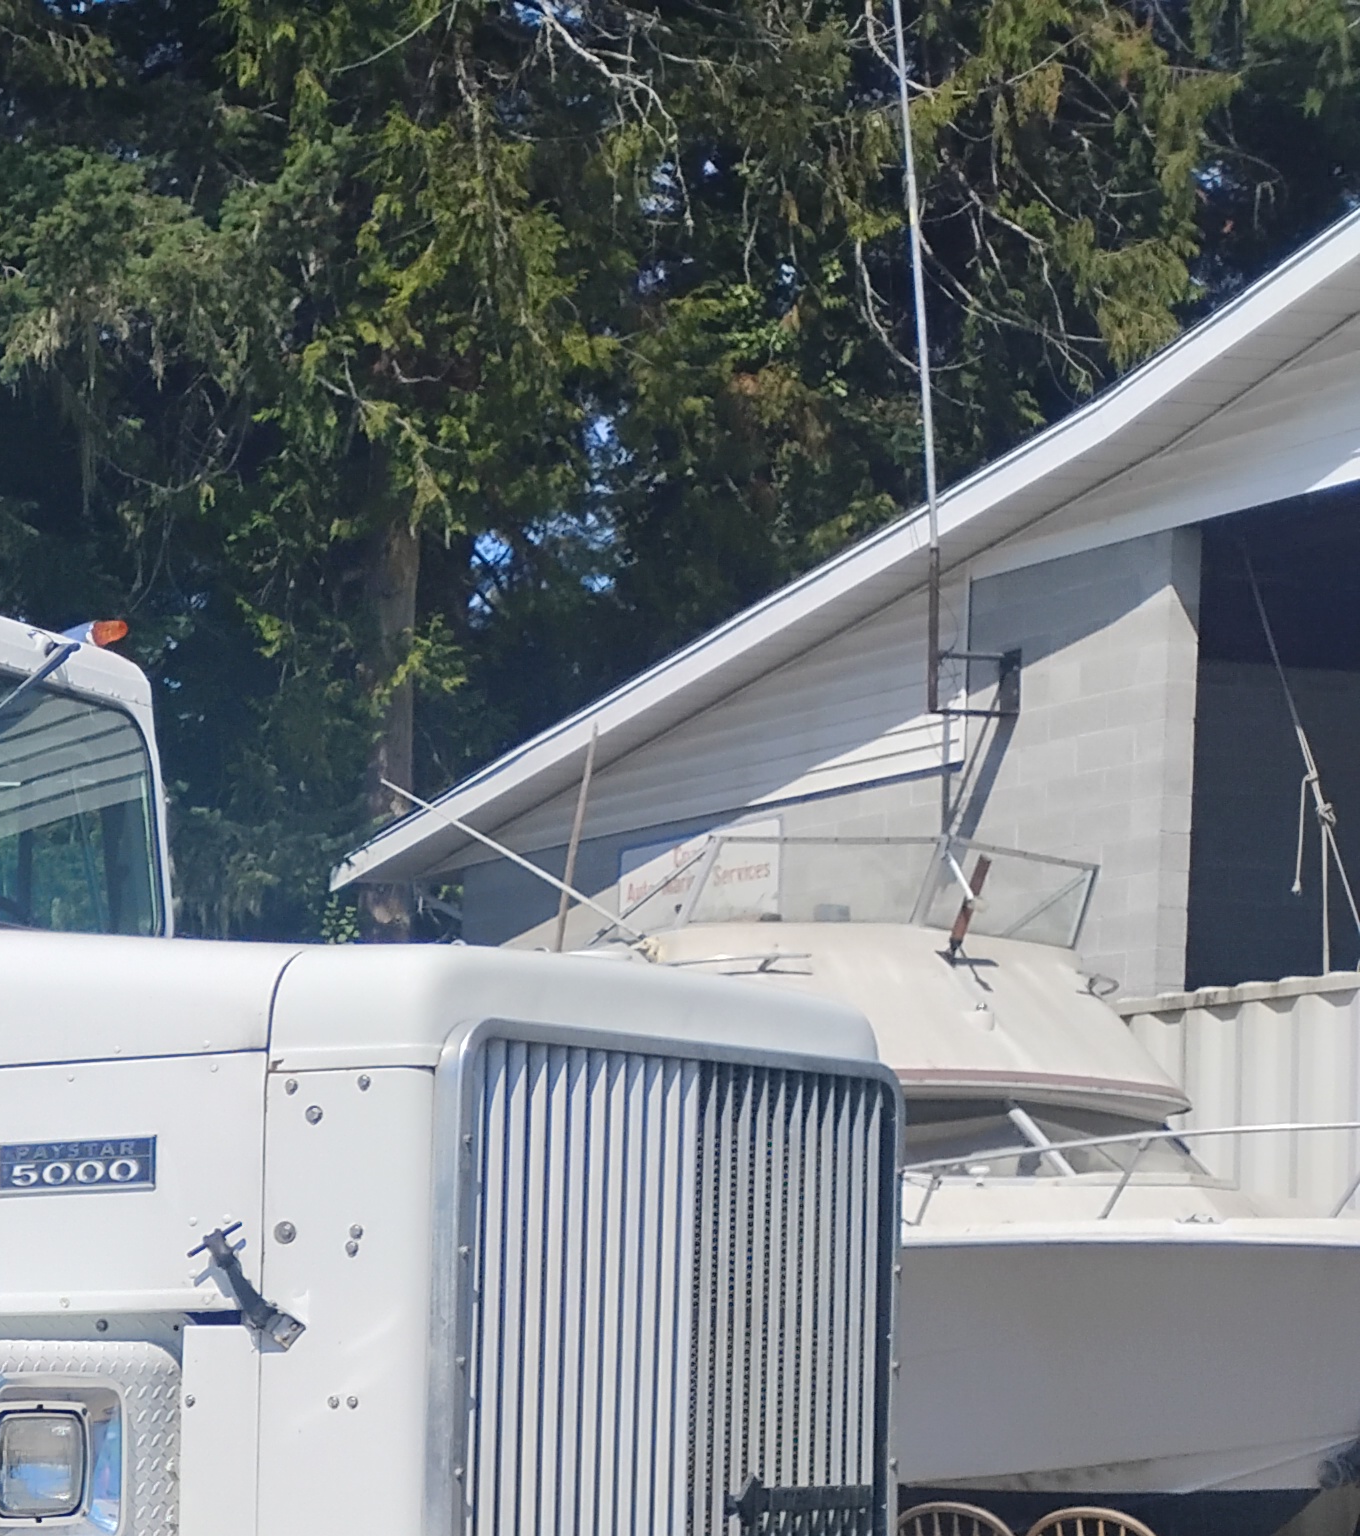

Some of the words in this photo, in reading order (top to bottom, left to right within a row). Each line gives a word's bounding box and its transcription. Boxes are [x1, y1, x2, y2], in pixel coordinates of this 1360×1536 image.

[713, 861, 771, 887] Services
[15, 1140, 137, 1161] PAYSTAR
[10, 1158, 140, 1188] 5000
